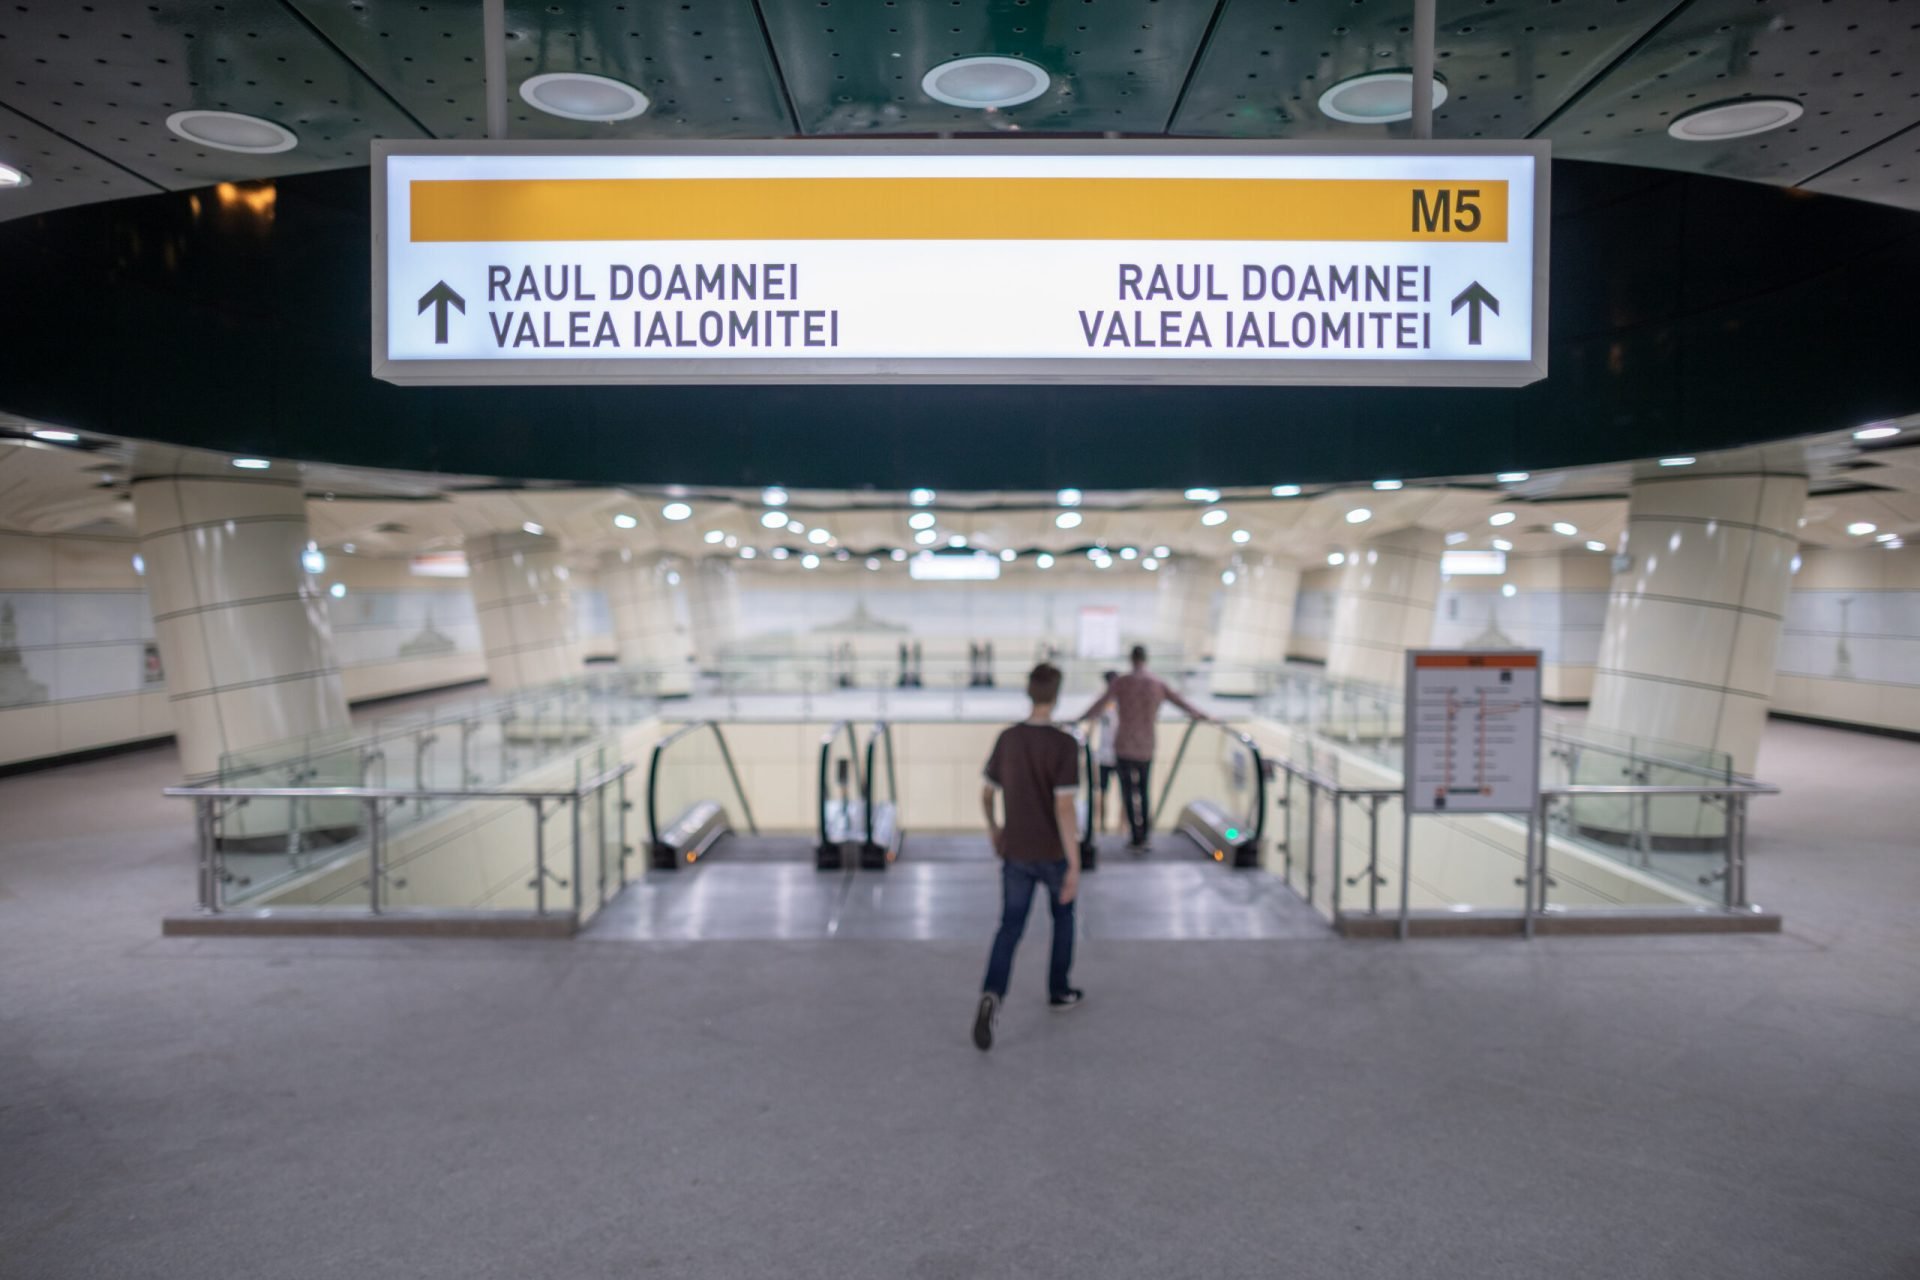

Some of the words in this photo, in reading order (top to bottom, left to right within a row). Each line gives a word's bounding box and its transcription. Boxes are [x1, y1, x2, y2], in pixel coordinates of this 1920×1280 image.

[1411, 189, 1482, 233] M5
[487, 264, 596, 302] RAUL
[609, 263, 798, 301] DOAMNEI
[1118, 263, 1229, 301] RAUL
[1242, 264, 1431, 303] DOAMNEI
[488, 310, 621, 348] VALEA
[633, 309, 838, 348] IALOMITEI
[1078, 310, 1213, 348] VALEA
[1226, 311, 1431, 350] IALOMITEI
